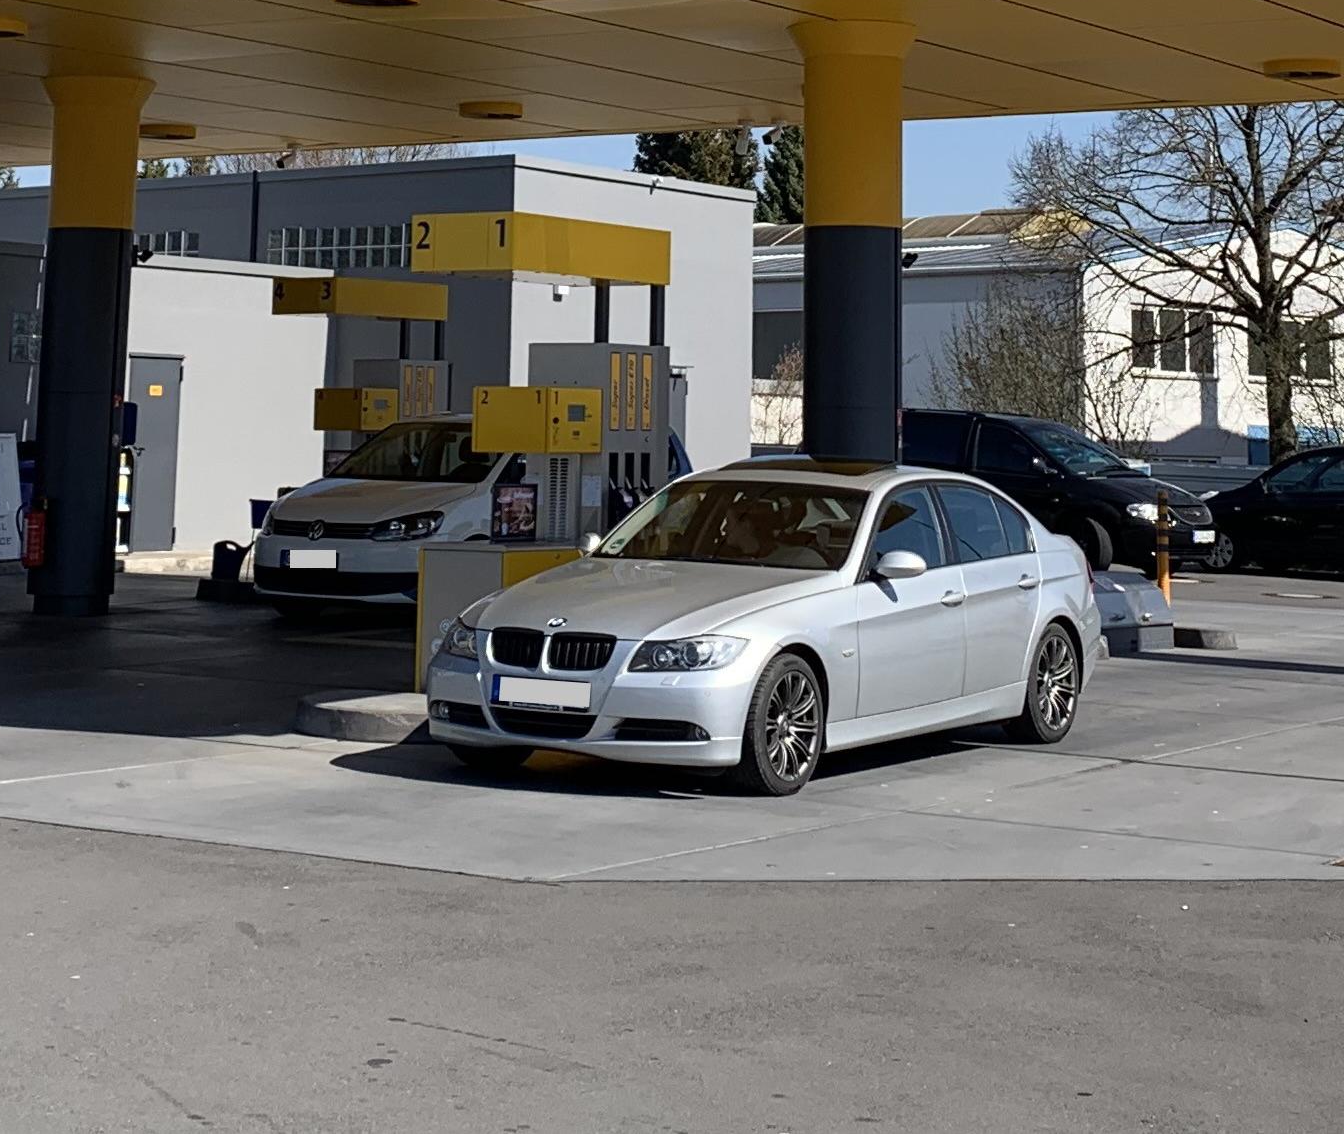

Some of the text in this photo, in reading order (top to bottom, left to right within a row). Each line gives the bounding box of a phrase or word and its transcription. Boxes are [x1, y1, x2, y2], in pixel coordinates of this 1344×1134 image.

[416, 221, 430, 250] 2
[495, 218, 506, 248] 1
[274, 282, 285, 301] 4
[321, 281, 332, 300] 3
[481, 390, 489, 405] 2
[535, 390, 542, 405] 1
